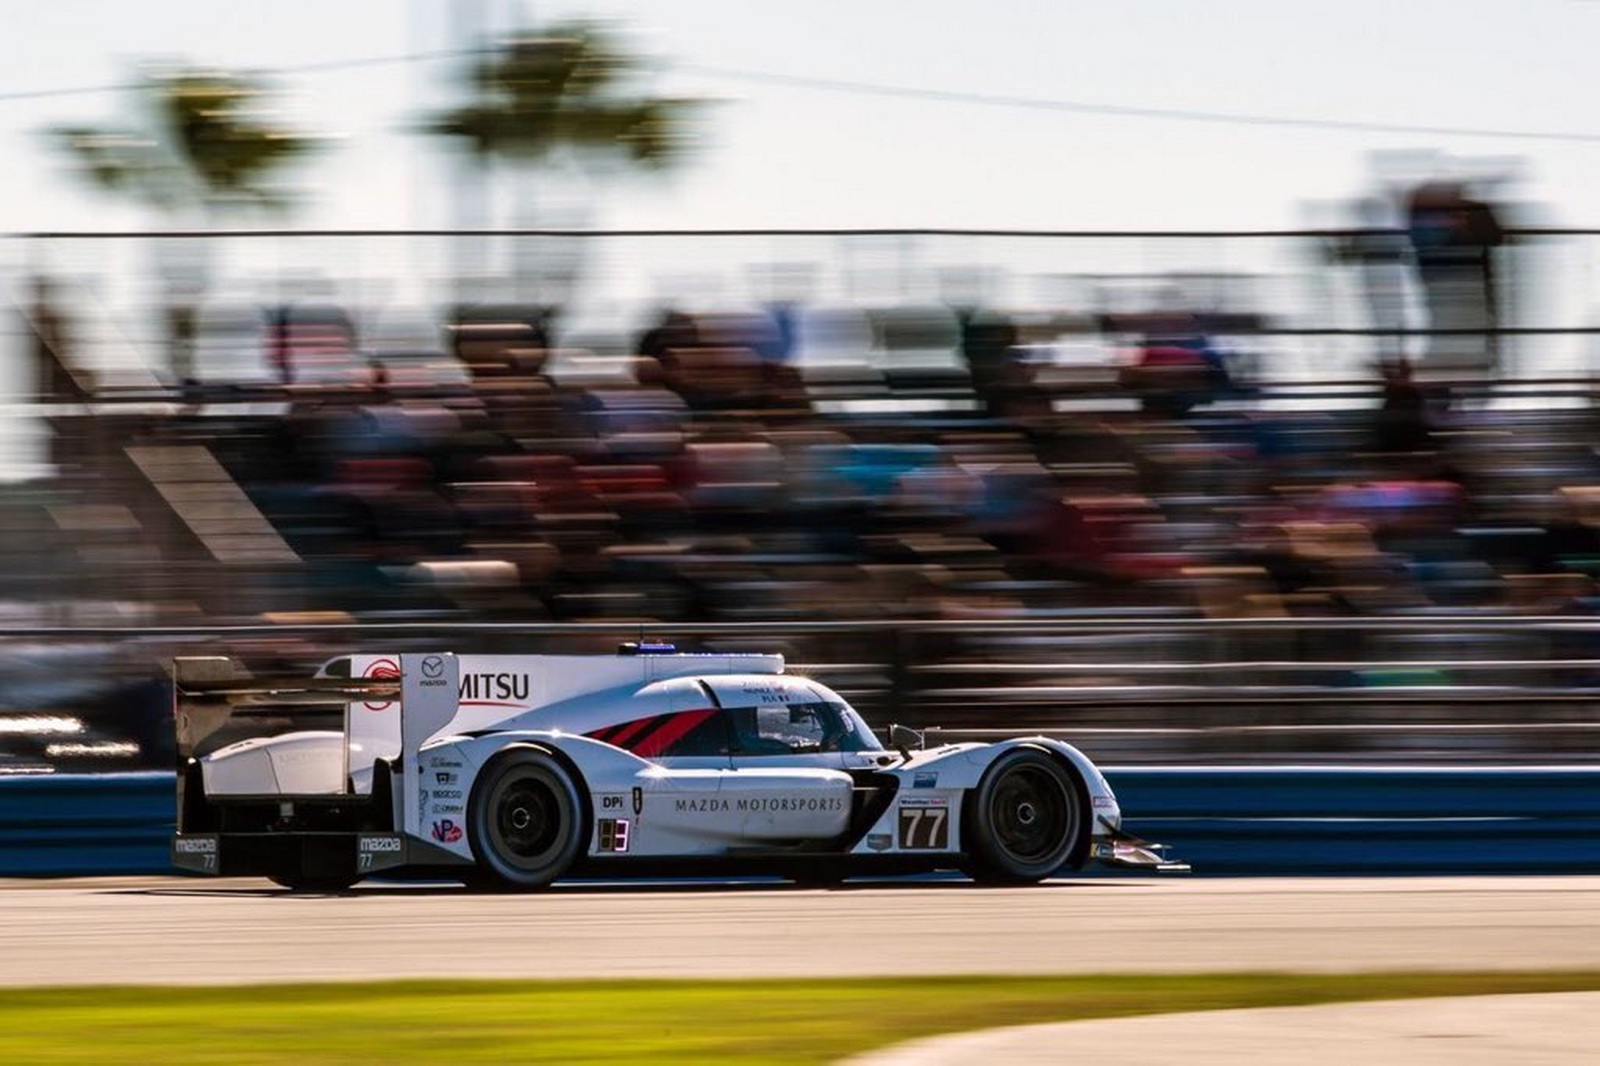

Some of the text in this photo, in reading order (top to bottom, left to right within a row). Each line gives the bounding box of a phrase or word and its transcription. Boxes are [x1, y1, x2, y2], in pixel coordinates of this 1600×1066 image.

[602, 796, 624, 808] DPi
[675, 797, 843, 812] MAZDA MOTORSPORTS
[901, 809, 946, 847] 77
[176, 838, 216, 853] mazda
[360, 838, 401, 851] mazda
[202, 854, 216, 868] 77
[360, 853, 373, 867] 77
